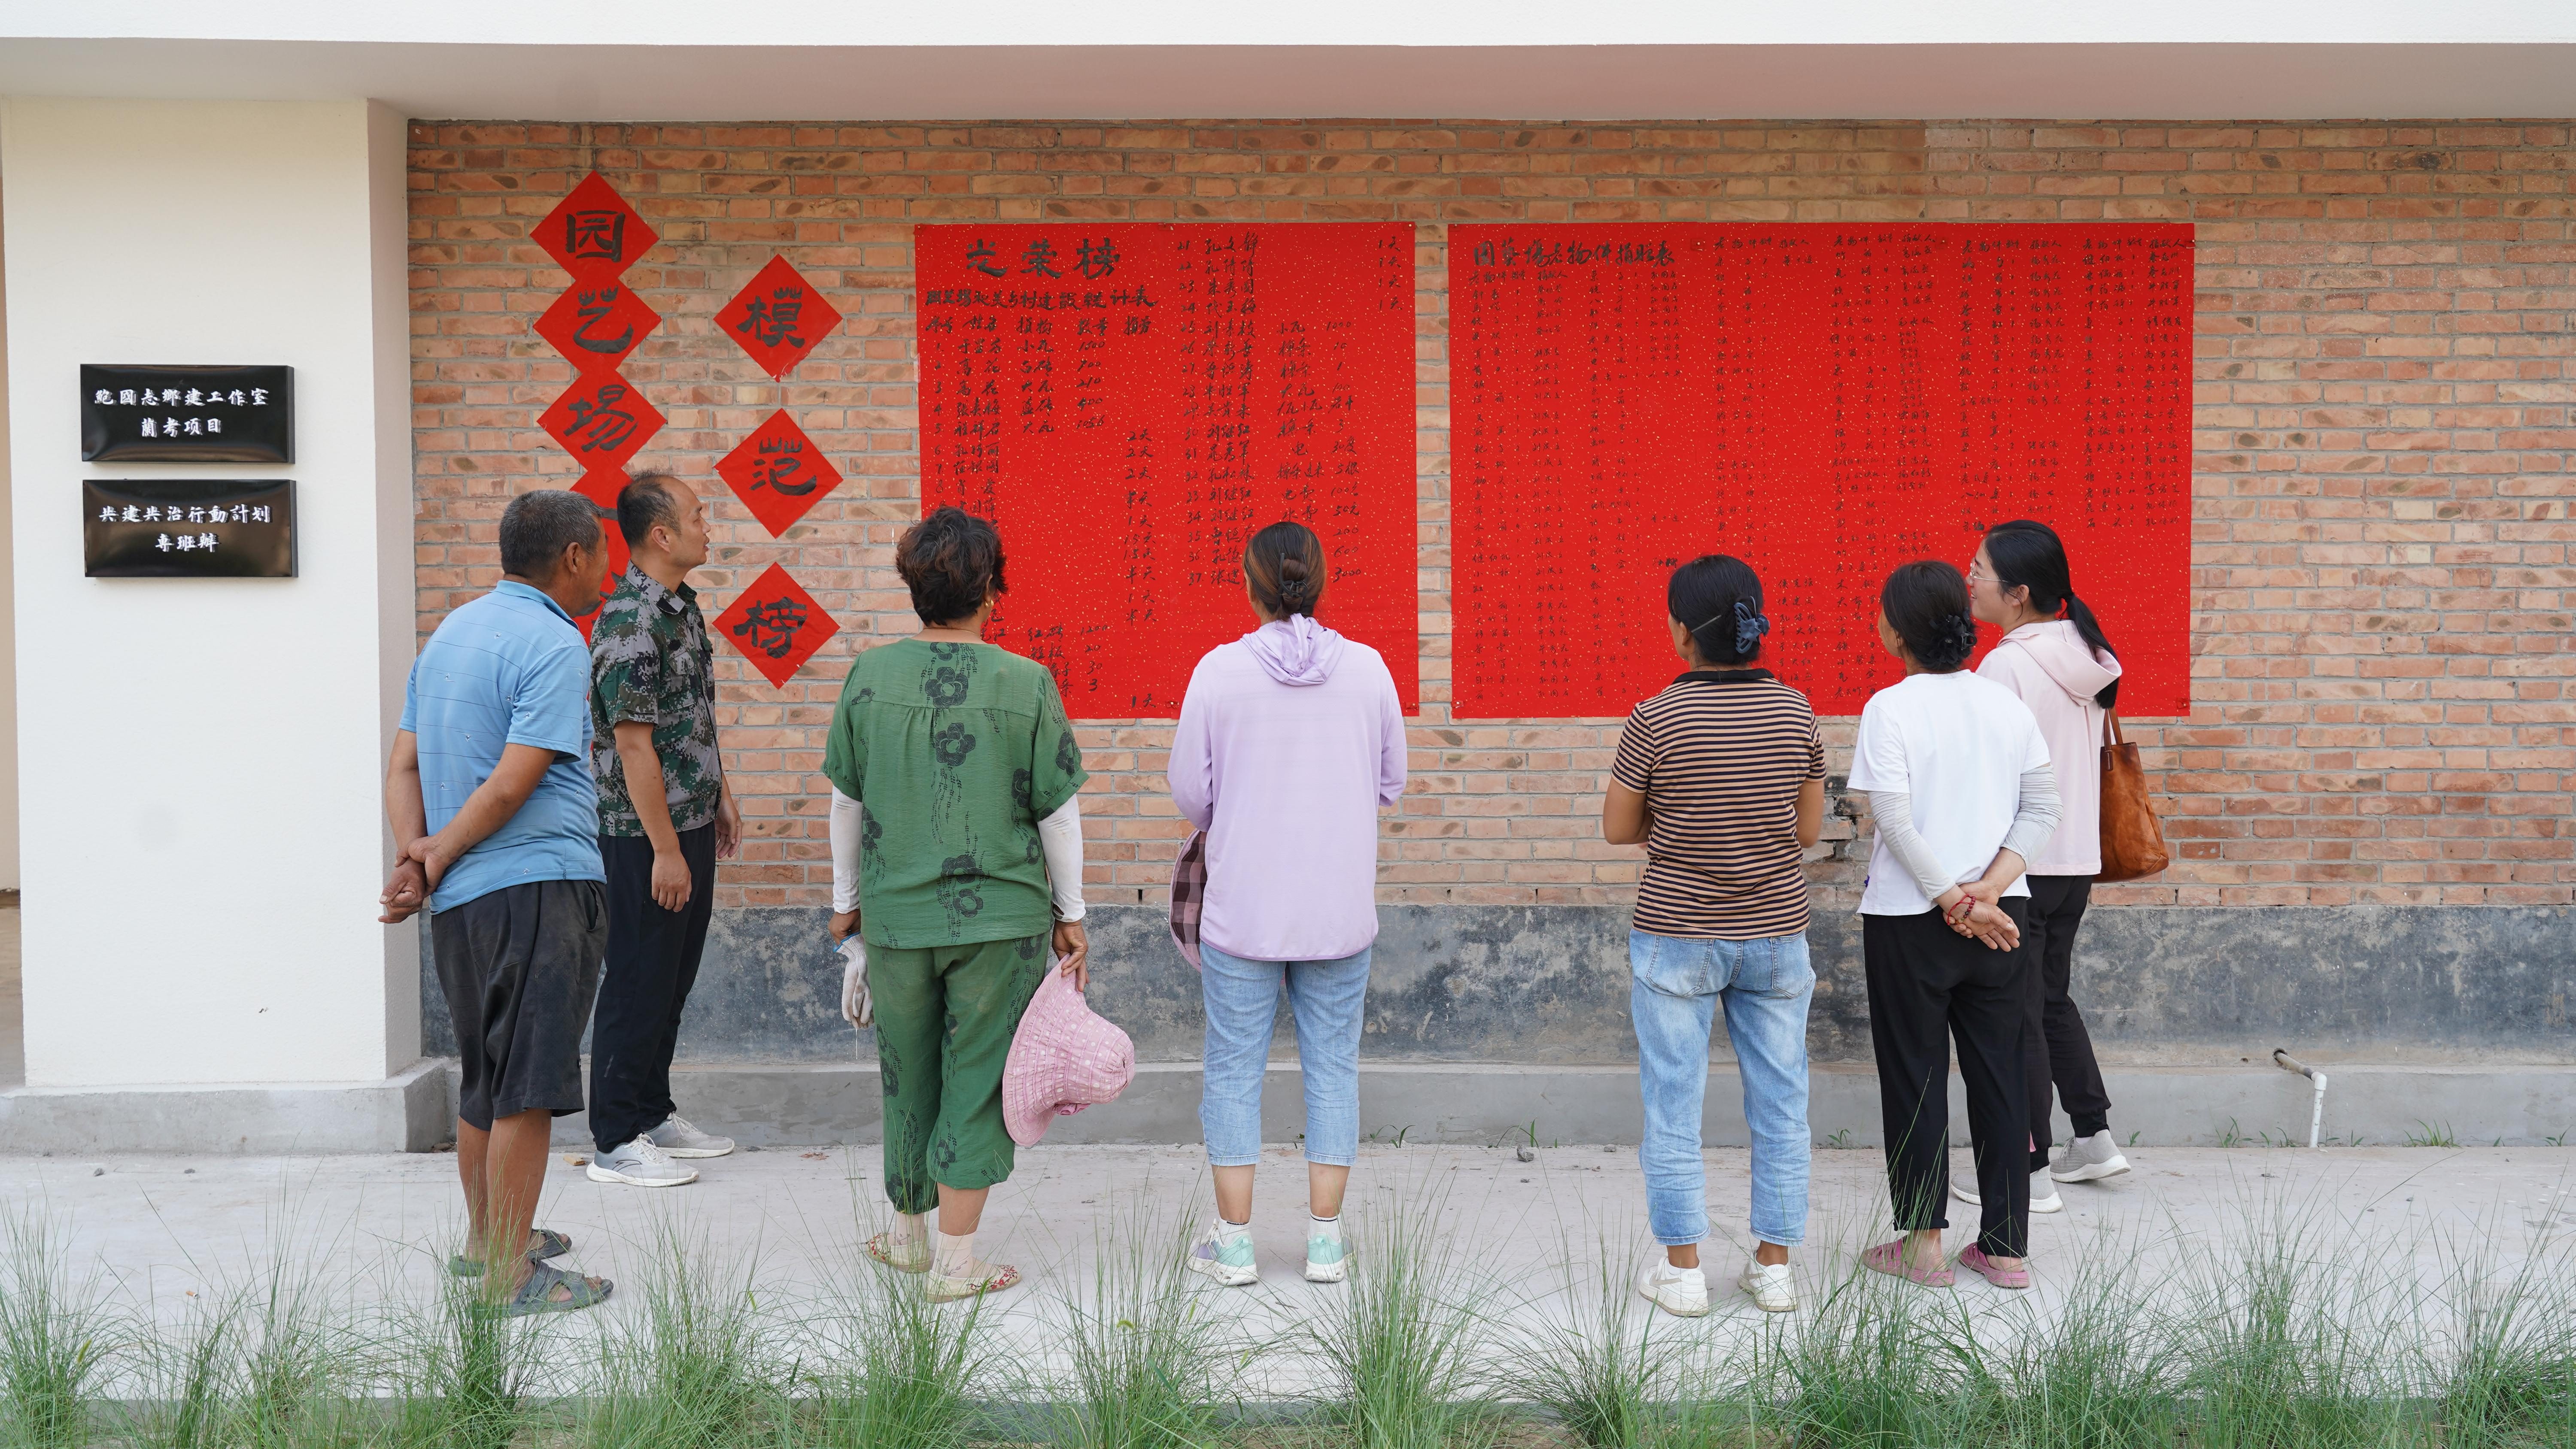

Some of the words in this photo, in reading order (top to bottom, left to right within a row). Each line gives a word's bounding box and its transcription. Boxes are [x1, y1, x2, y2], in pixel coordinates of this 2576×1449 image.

[966, 237, 1120, 279] 光荣榜
[963, 315, 997, 333] 姓名
[1125, 446, 1154, 458] 2天
[1292, 442, 1309, 456] 电
[733, 286, 817, 659] 模范榜
[1125, 467, 1152, 480] 2天
[1333, 526, 1358, 536] 200
[1334, 546, 1358, 557] 600
[1333, 567, 1361, 582] 3000
[1087, 661, 1102, 674] 30
[1089, 679, 1099, 691] 3
